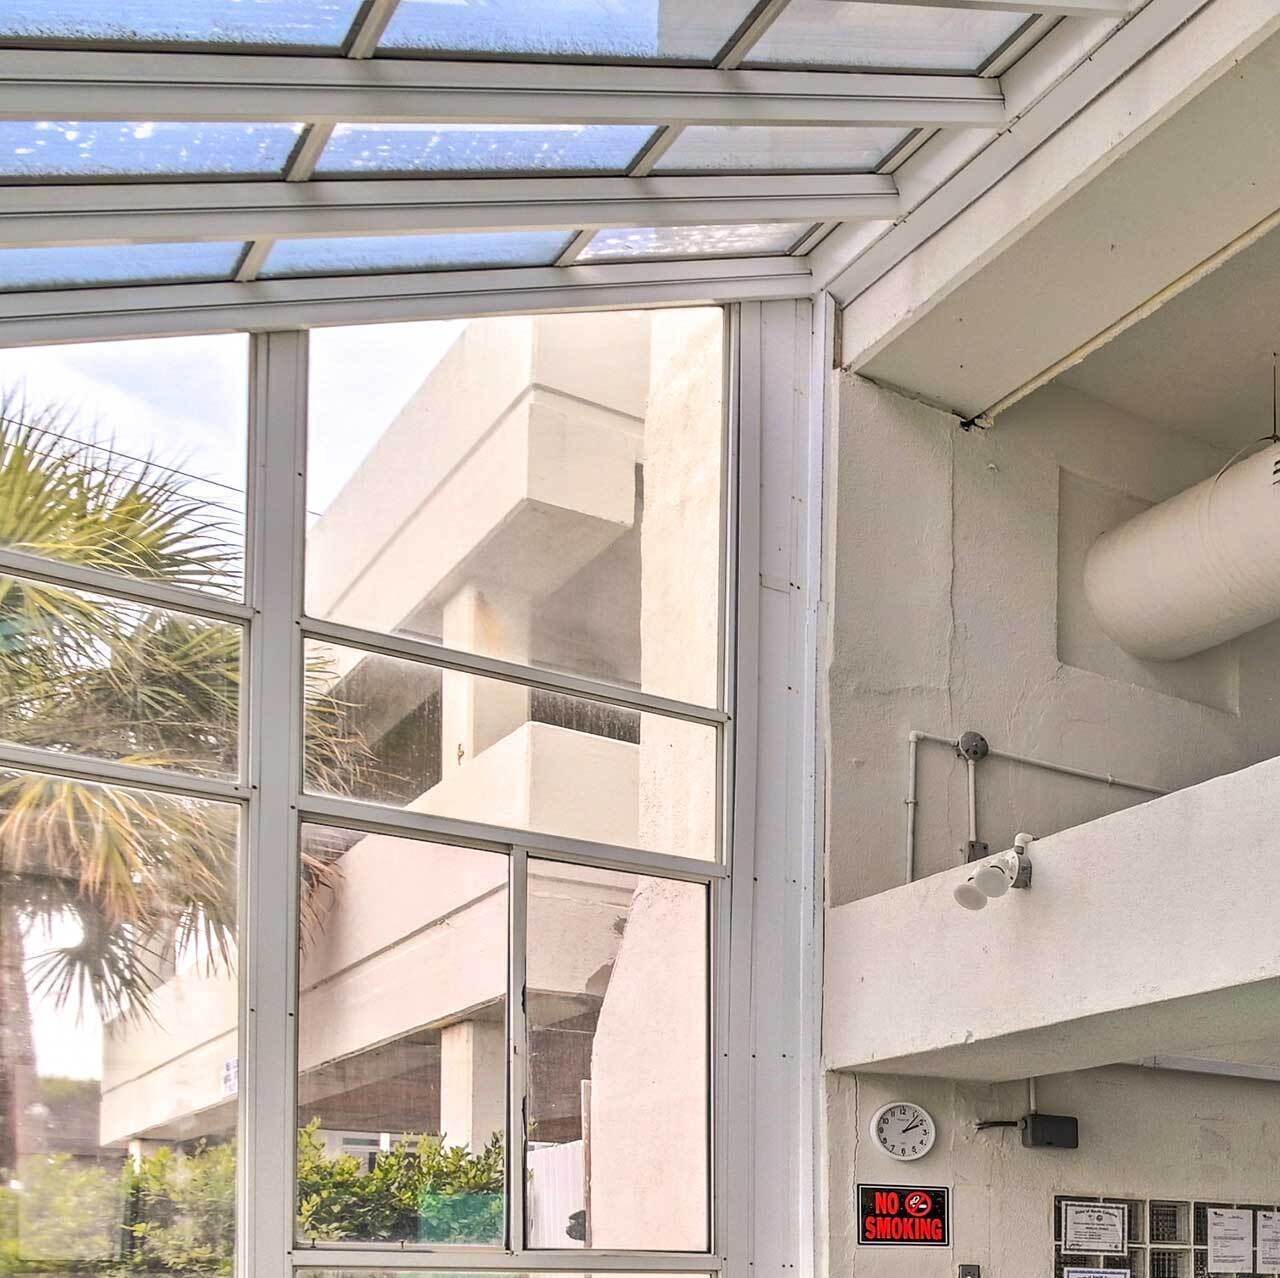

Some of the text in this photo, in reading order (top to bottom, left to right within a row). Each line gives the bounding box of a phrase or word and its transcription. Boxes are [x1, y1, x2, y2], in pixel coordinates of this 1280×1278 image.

[900, 1106, 906, 1115] 12
[875, 1192, 899, 1214] NO
[865, 1216, 942, 1240] SMOKING
